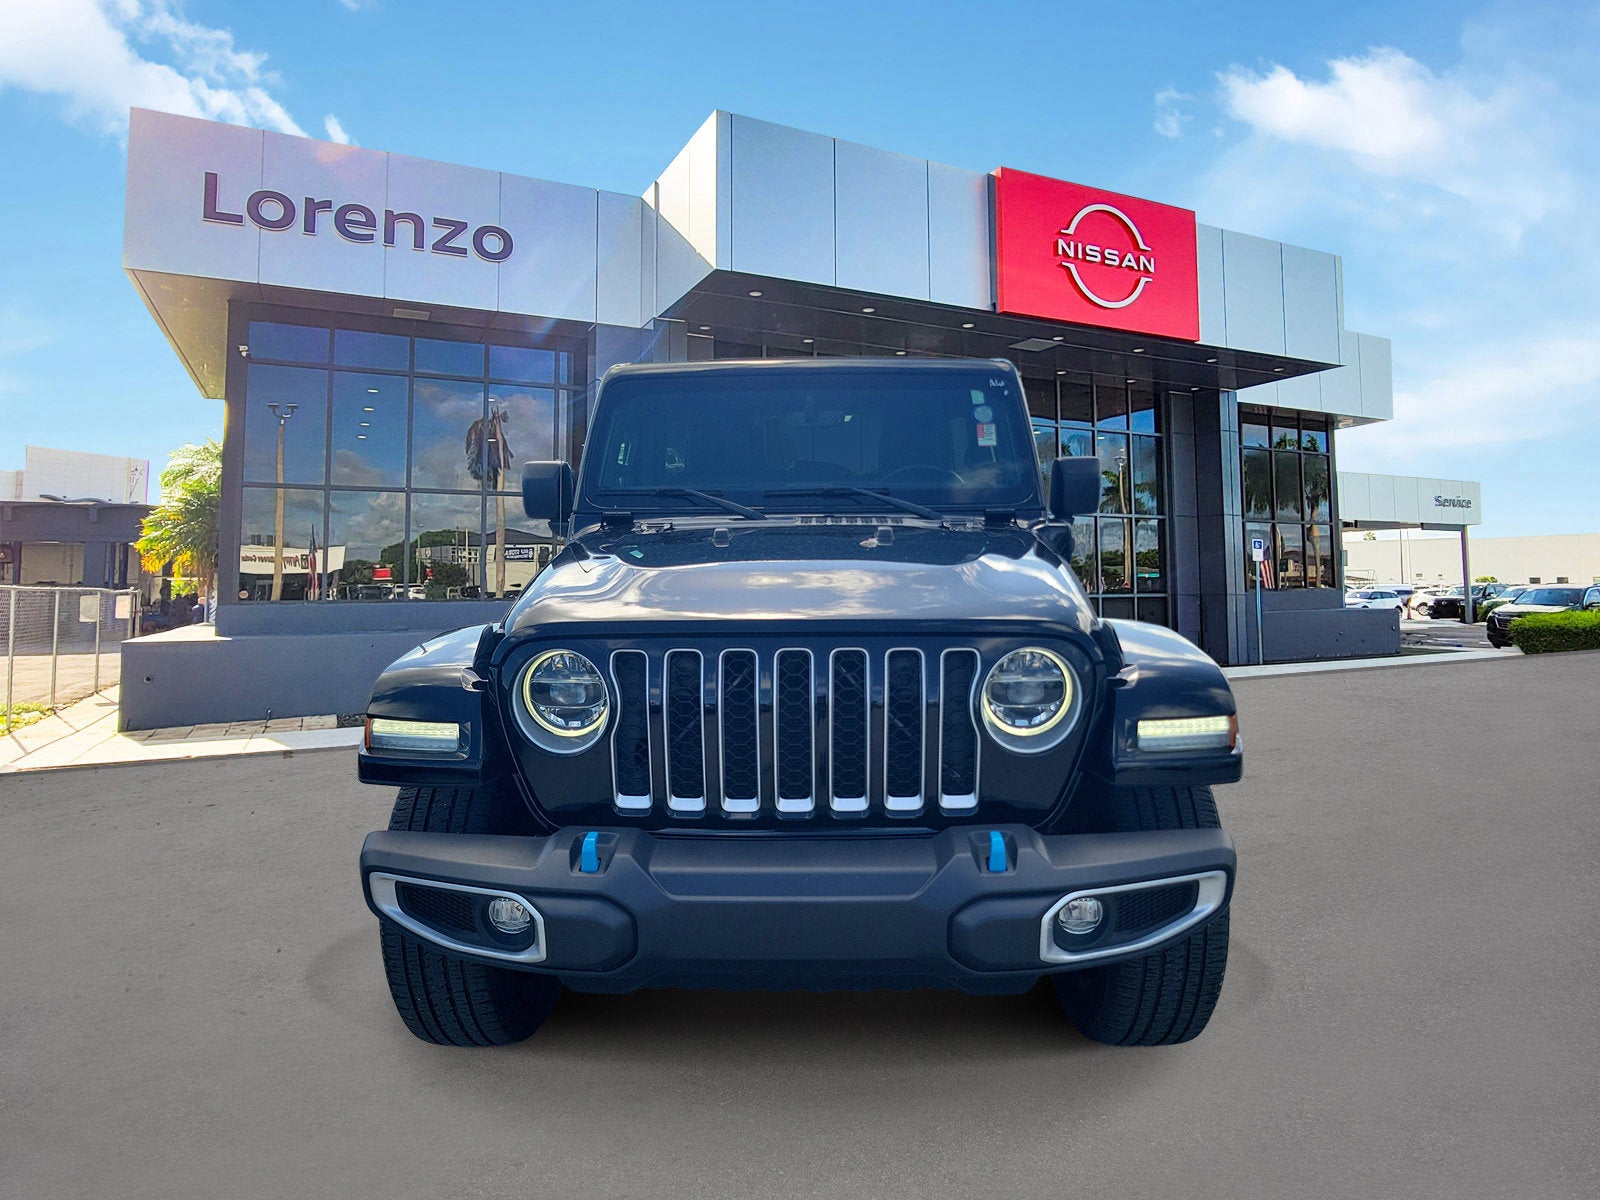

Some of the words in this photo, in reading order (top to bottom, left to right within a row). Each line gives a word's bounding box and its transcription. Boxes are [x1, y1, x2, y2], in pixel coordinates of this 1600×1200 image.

[202, 171, 514, 262] Lorenzo
[1057, 238, 1155, 273] NISSAN
[1434, 495, 1472, 509] Service
